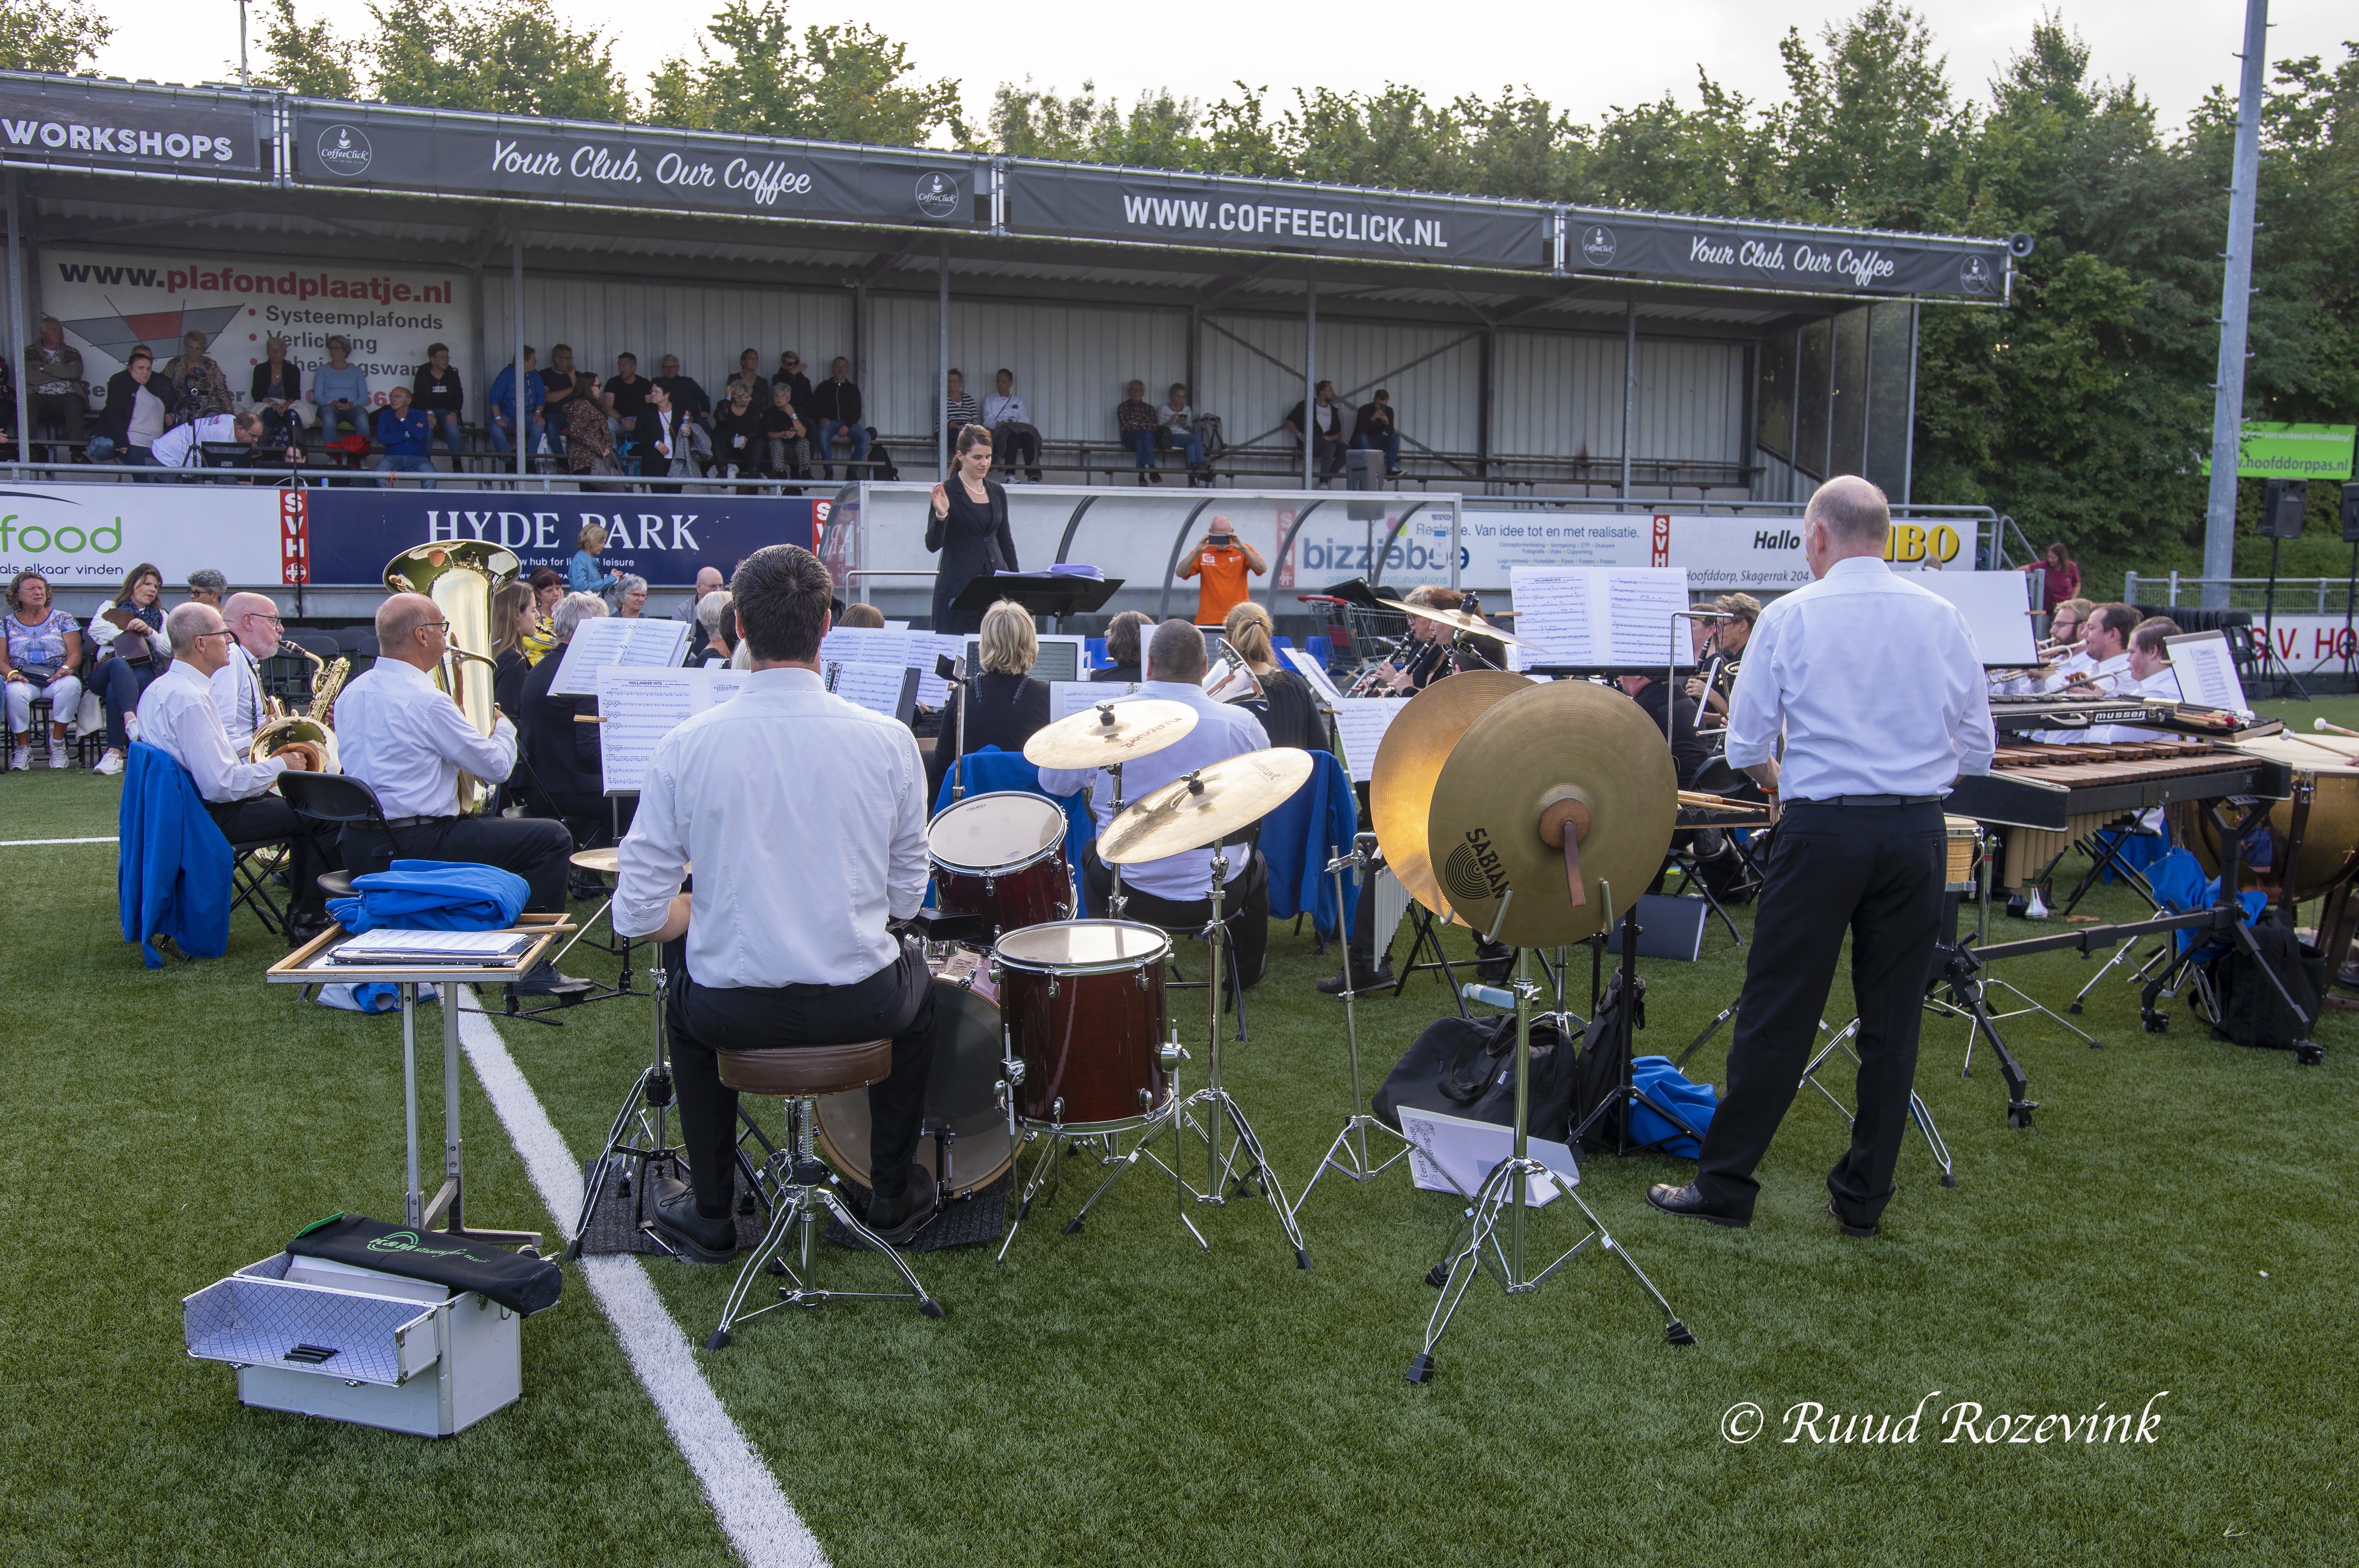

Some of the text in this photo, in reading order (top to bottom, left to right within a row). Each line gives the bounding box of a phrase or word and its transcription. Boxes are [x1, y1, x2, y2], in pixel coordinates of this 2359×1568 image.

[1, 118, 232, 161] WORKSHOPS
[322, 149, 368, 161] CoffeeClick
[493, 139, 812, 205] Your Club, Our Coffee
[1123, 195, 1448, 248] WWW.COFFEECLICK.NL
[1690, 235, 1894, 287] Your Club, Our Coffee
[58, 263, 451, 305] www.plafondplaatje.nl
[266, 305, 443, 329] Systeemplafonds
[427, 511, 559, 548] HYDE
[1475, 524, 1496, 536] Van
[1500, 524, 1525, 537] idee
[1528, 526, 1543, 537] tot
[1546, 528, 1560, 537] en
[1564, 526, 1585, 537] met
[1588, 526, 1640, 538] realisatie.
[1654, 517, 1667, 567] SVH
[1754, 530, 1801, 549] Hallo
[24, 564, 71, 574] elkaar
[76, 564, 124, 575] vinden
[530, 557, 547, 566] hub
[551, 557, 563, 566] for
[603, 558, 634, 566] leisure
[1741, 570, 1788, 585] Skagerrak
[1791, 571, 1810, 582] 204
[1466, 828, 1513, 899] SABIAN
[1409, 1127, 1428, 1178] Eerst voende
[369, 1238, 417, 1251] K&M
[464, 1254, 491, 1263] music
